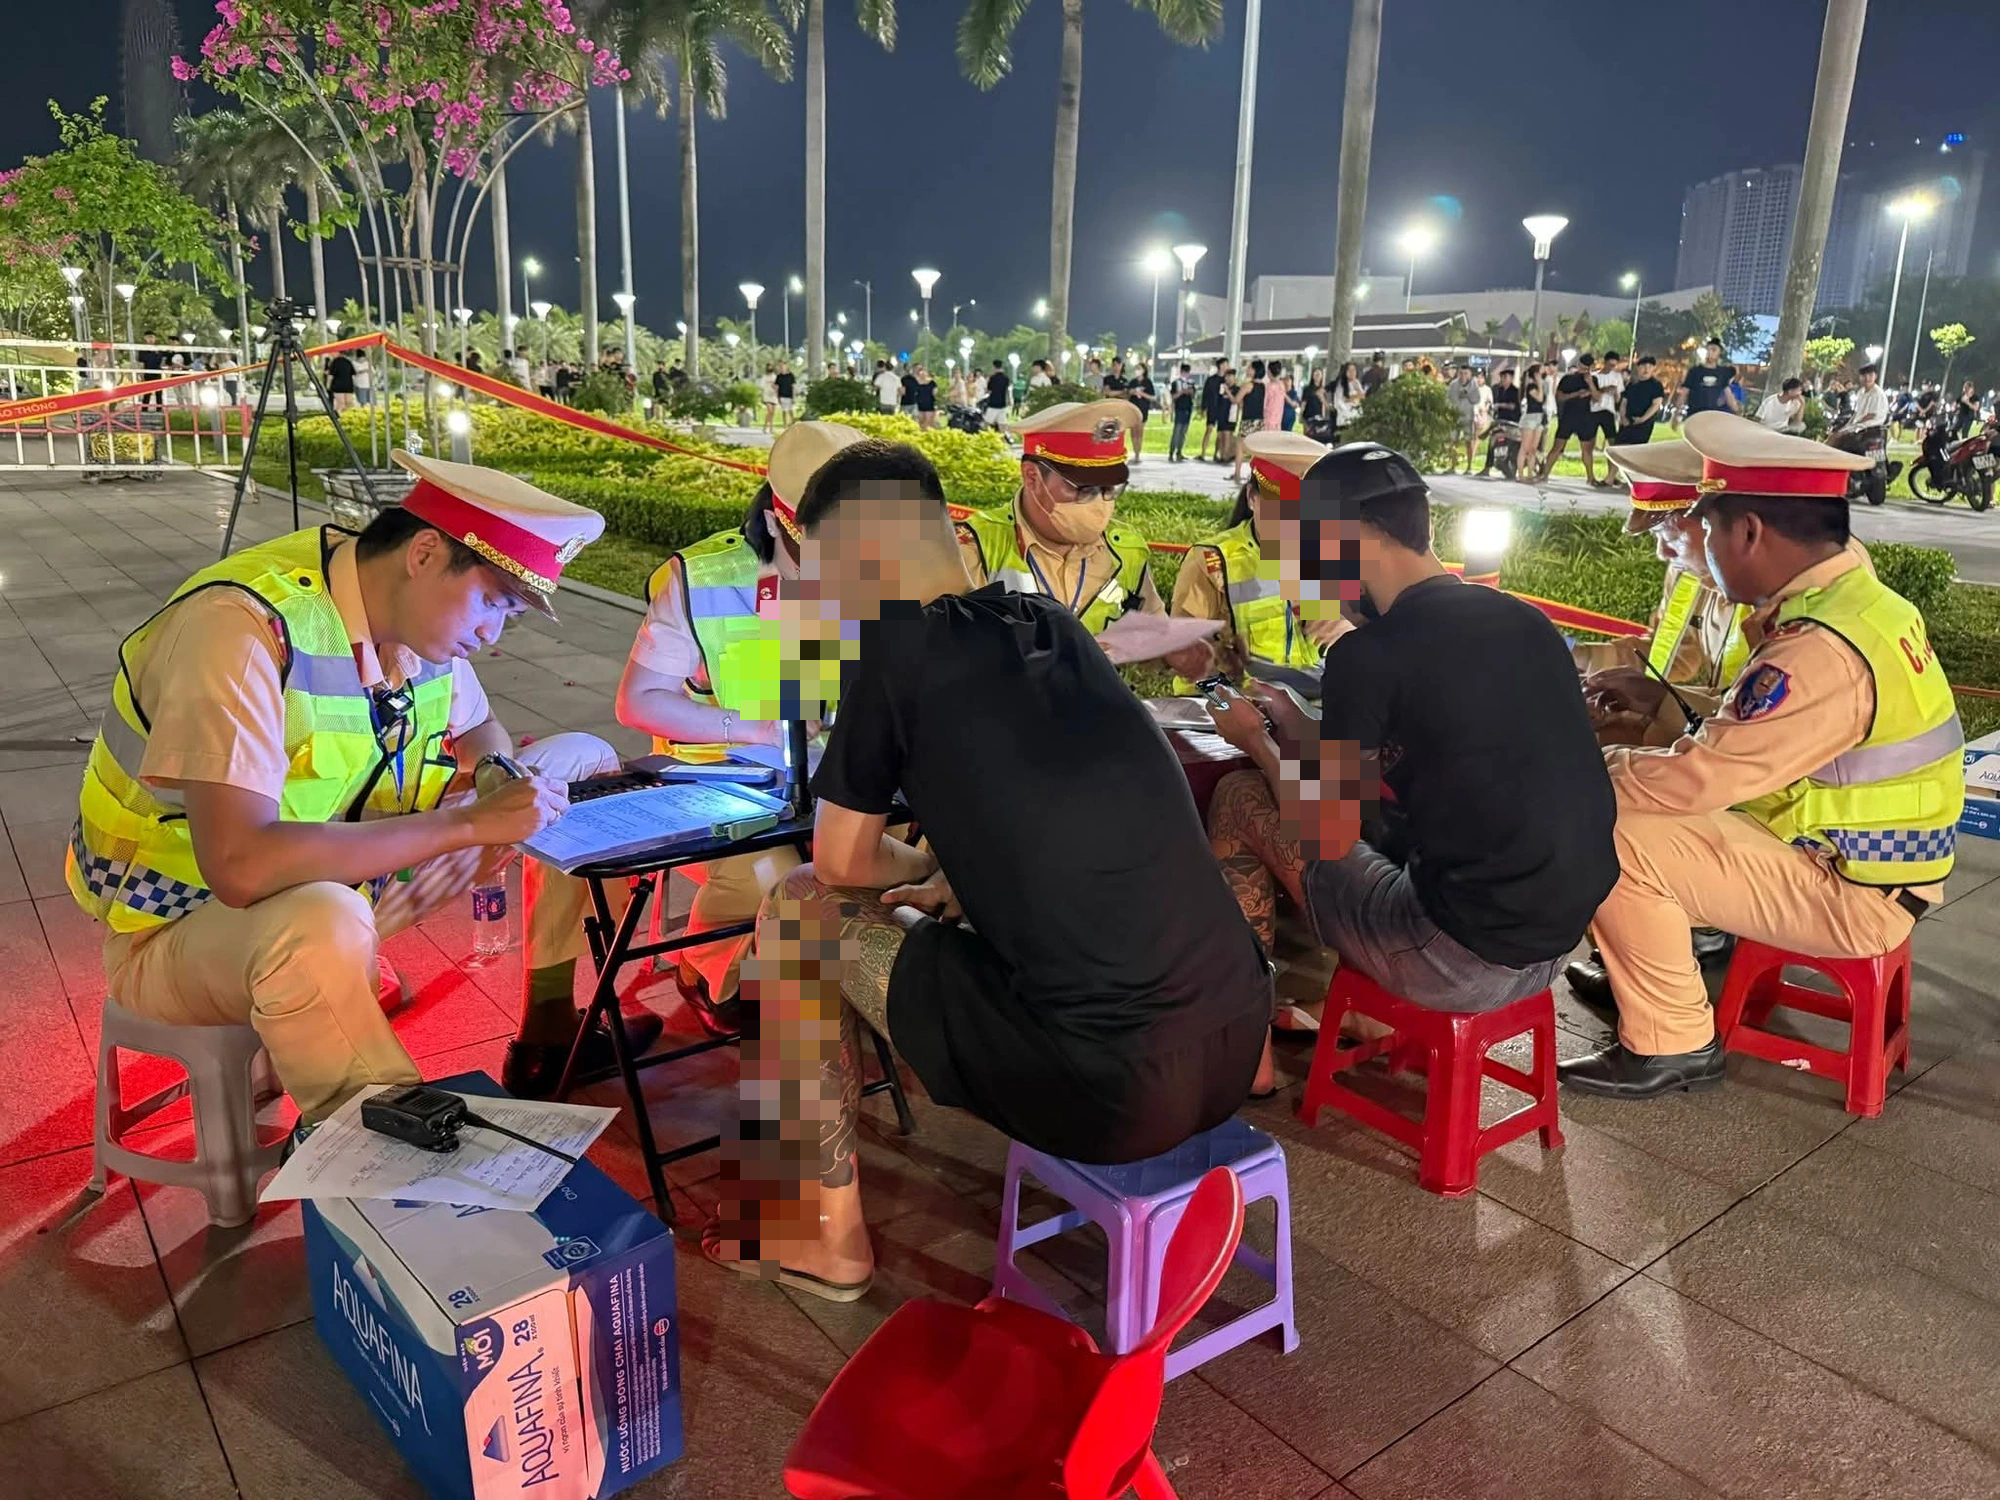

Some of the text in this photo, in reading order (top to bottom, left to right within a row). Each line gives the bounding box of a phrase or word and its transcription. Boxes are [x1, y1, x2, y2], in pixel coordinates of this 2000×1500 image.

[15, 401, 58, 414] THÔNG
[448, 1290, 473, 1309] 28
[609, 1274, 622, 1336] AQUAFINA
[334, 1261, 431, 1436] AQUAFINA
[513, 1319, 530, 1347] 28
[614, 1338, 624, 1368] CHAI
[507, 1352, 559, 1488] AQUAFINA
[617, 1406, 628, 1439] UỐNG
